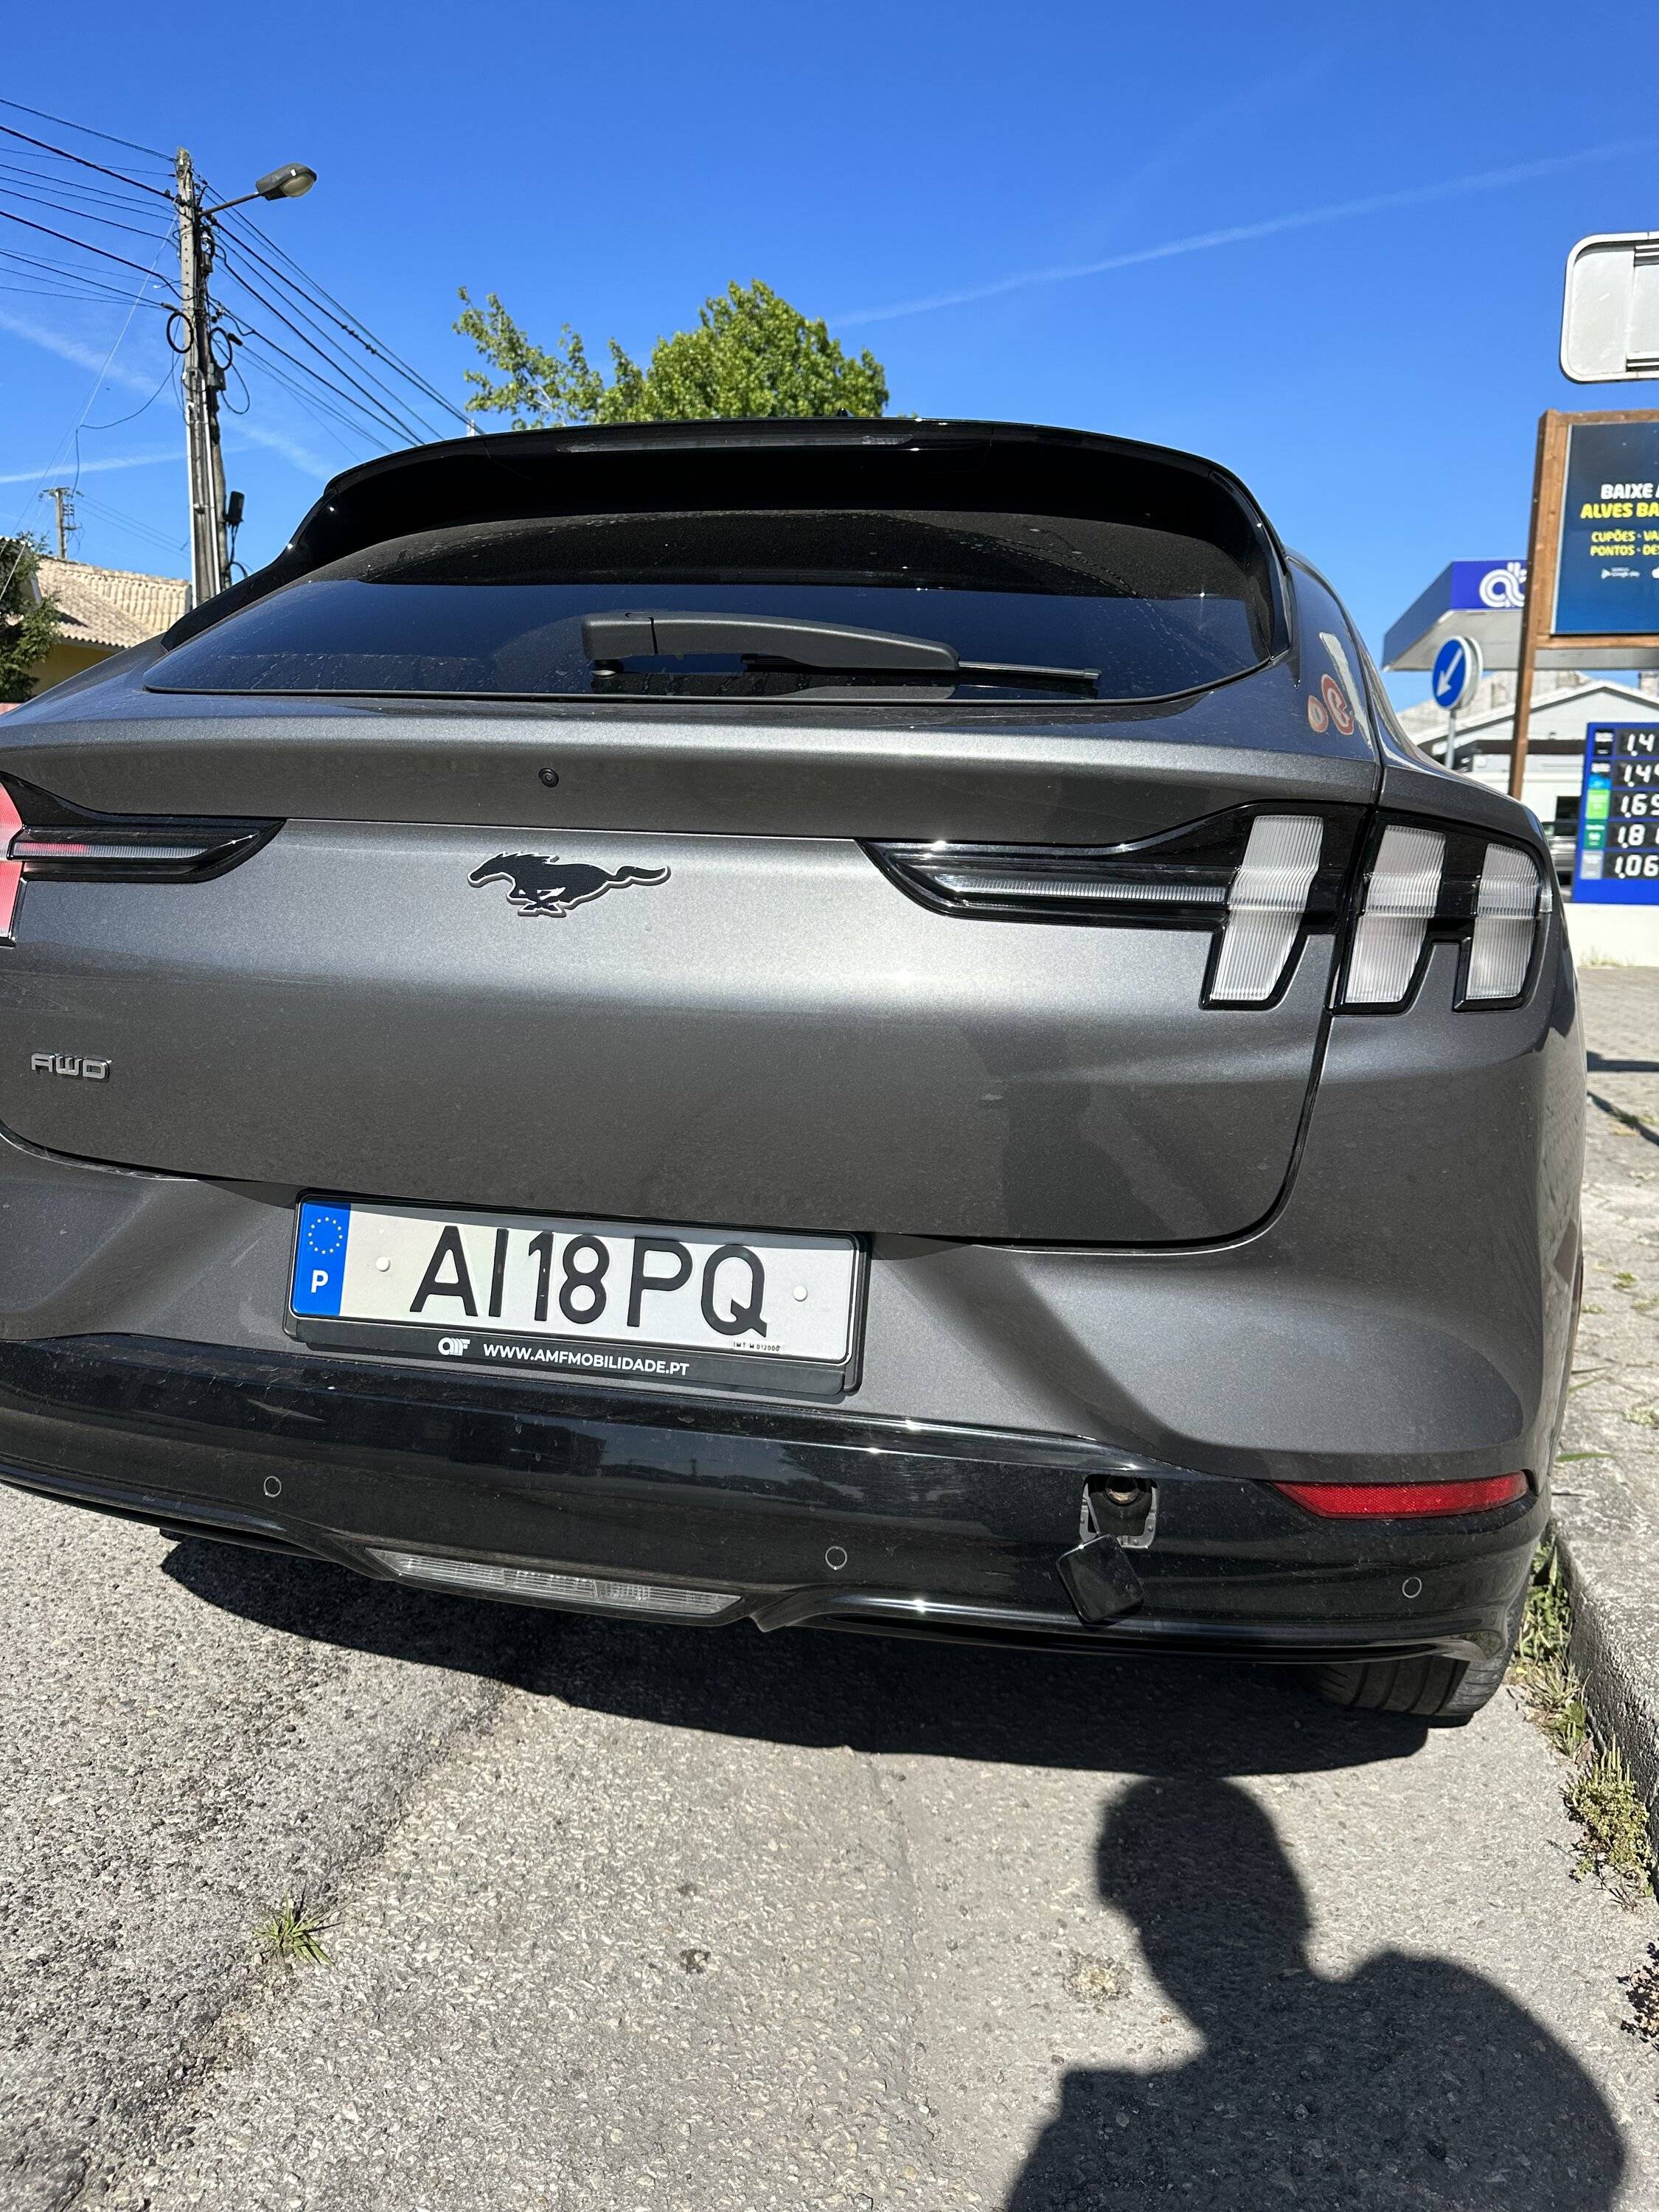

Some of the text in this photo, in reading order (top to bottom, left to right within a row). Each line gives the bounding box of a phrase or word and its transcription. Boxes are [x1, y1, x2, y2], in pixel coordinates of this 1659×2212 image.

[1601, 483, 1653, 499] BAIXE
[1580, 503, 1633, 518] ALVES
[1591, 529, 1635, 542] CUPÕES
[1590, 544, 1635, 556] PONTOS
[31, 1053, 108, 1079] AWD
[311, 1270, 329, 1293] P
[484, 1343, 689, 1376] WWW.AMFMOBILIDADE.PT
